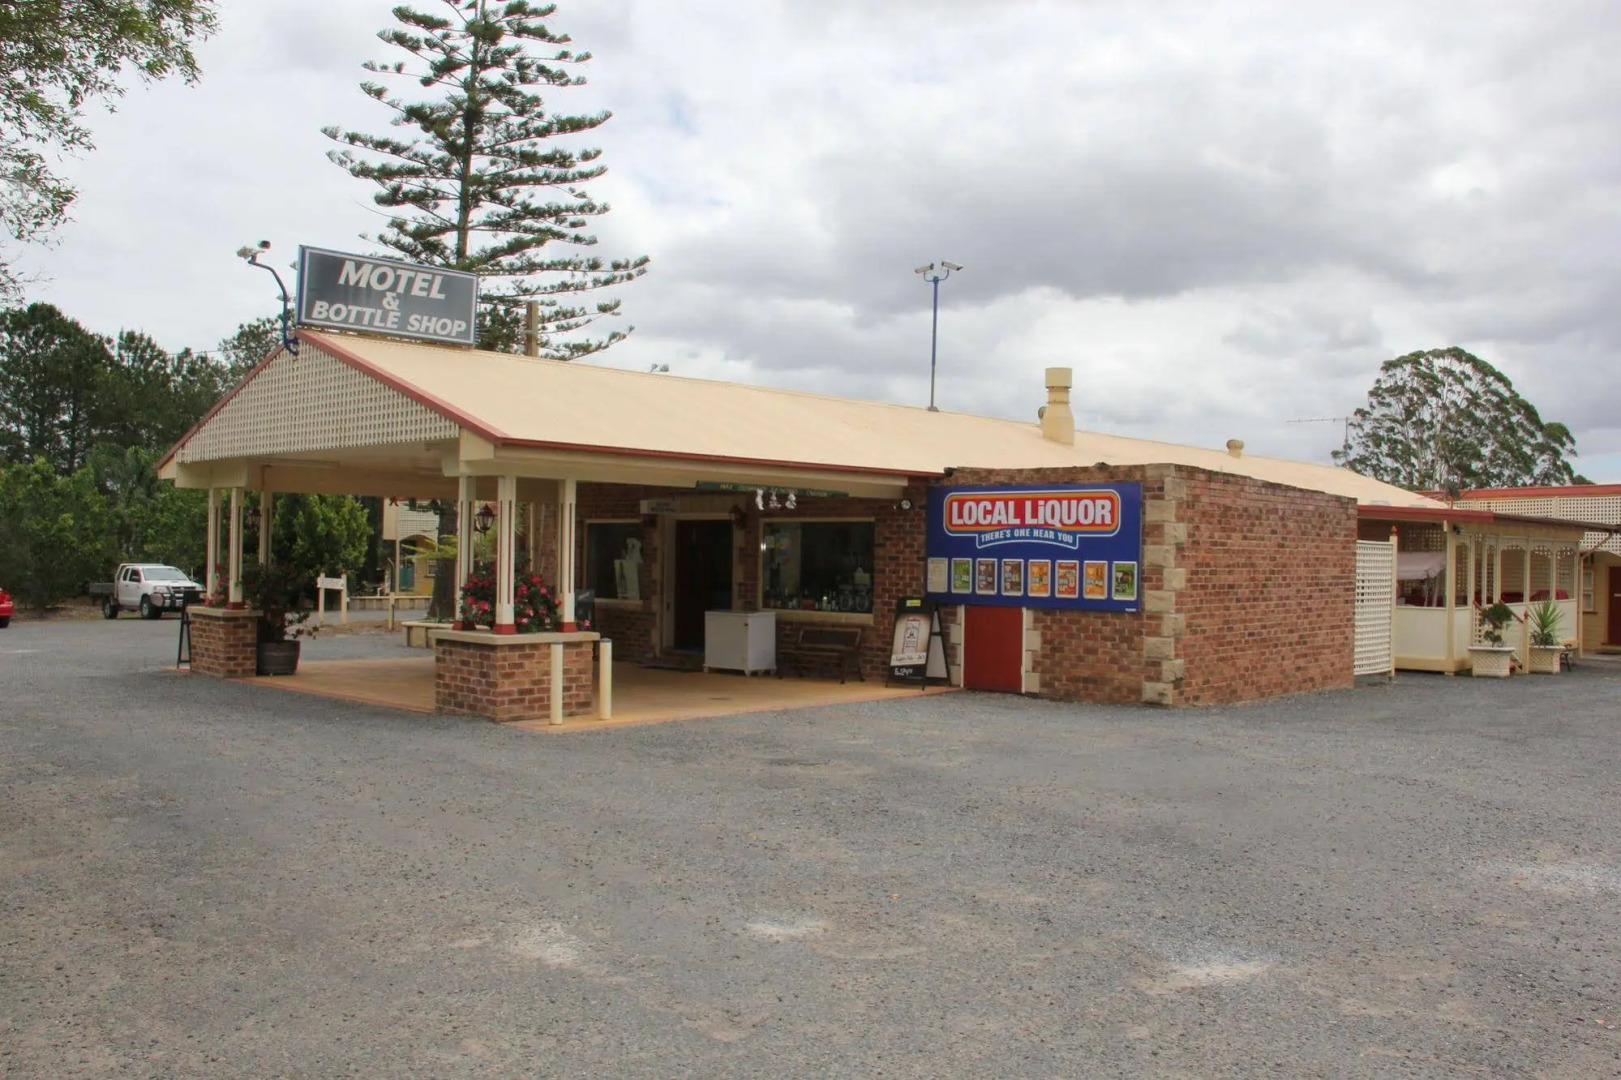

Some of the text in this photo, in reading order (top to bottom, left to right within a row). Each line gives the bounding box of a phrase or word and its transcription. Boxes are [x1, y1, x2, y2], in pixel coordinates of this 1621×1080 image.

[338, 261, 446, 299] MOTEL
[382, 291, 400, 311] &
[312, 301, 466, 336] BOTTLE SHOP
[951, 501, 1020, 525] LOCAL
[980, 528, 1073, 544] THERE'S ONE NEAR YOU
